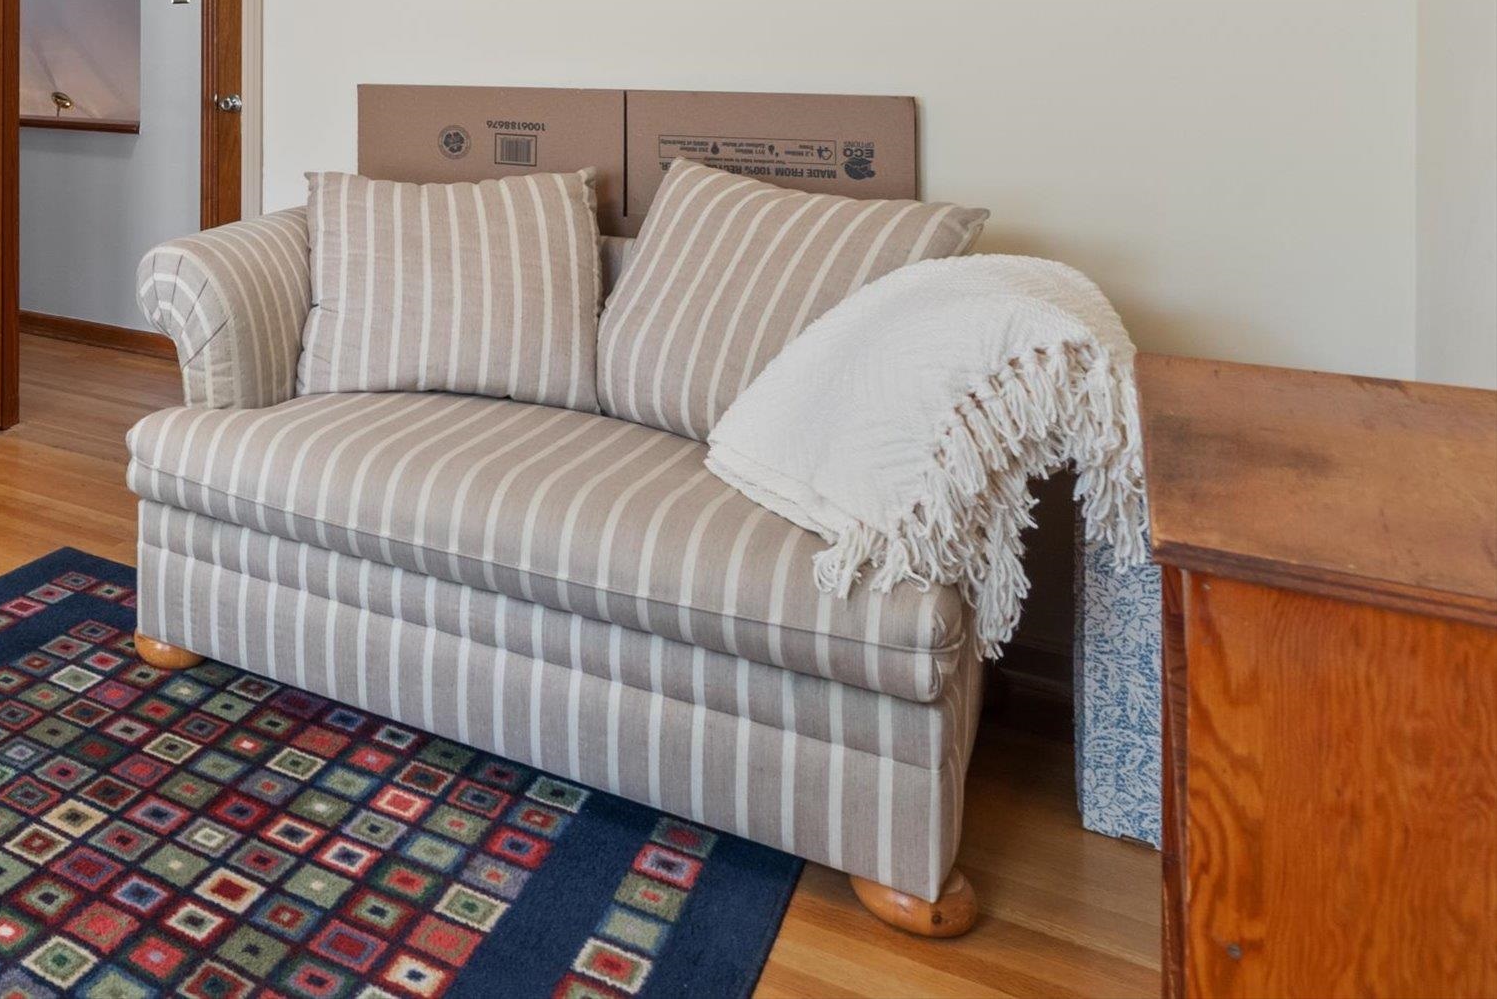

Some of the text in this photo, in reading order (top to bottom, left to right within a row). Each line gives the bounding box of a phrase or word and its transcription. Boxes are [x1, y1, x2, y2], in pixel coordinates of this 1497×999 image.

[486, 120, 546, 131] 1006188676
[843, 148, 874, 158] ECO
[743, 164, 770, 176] 100%
[774, 166, 804, 178] FROM
[806, 168, 837, 179] MADE
